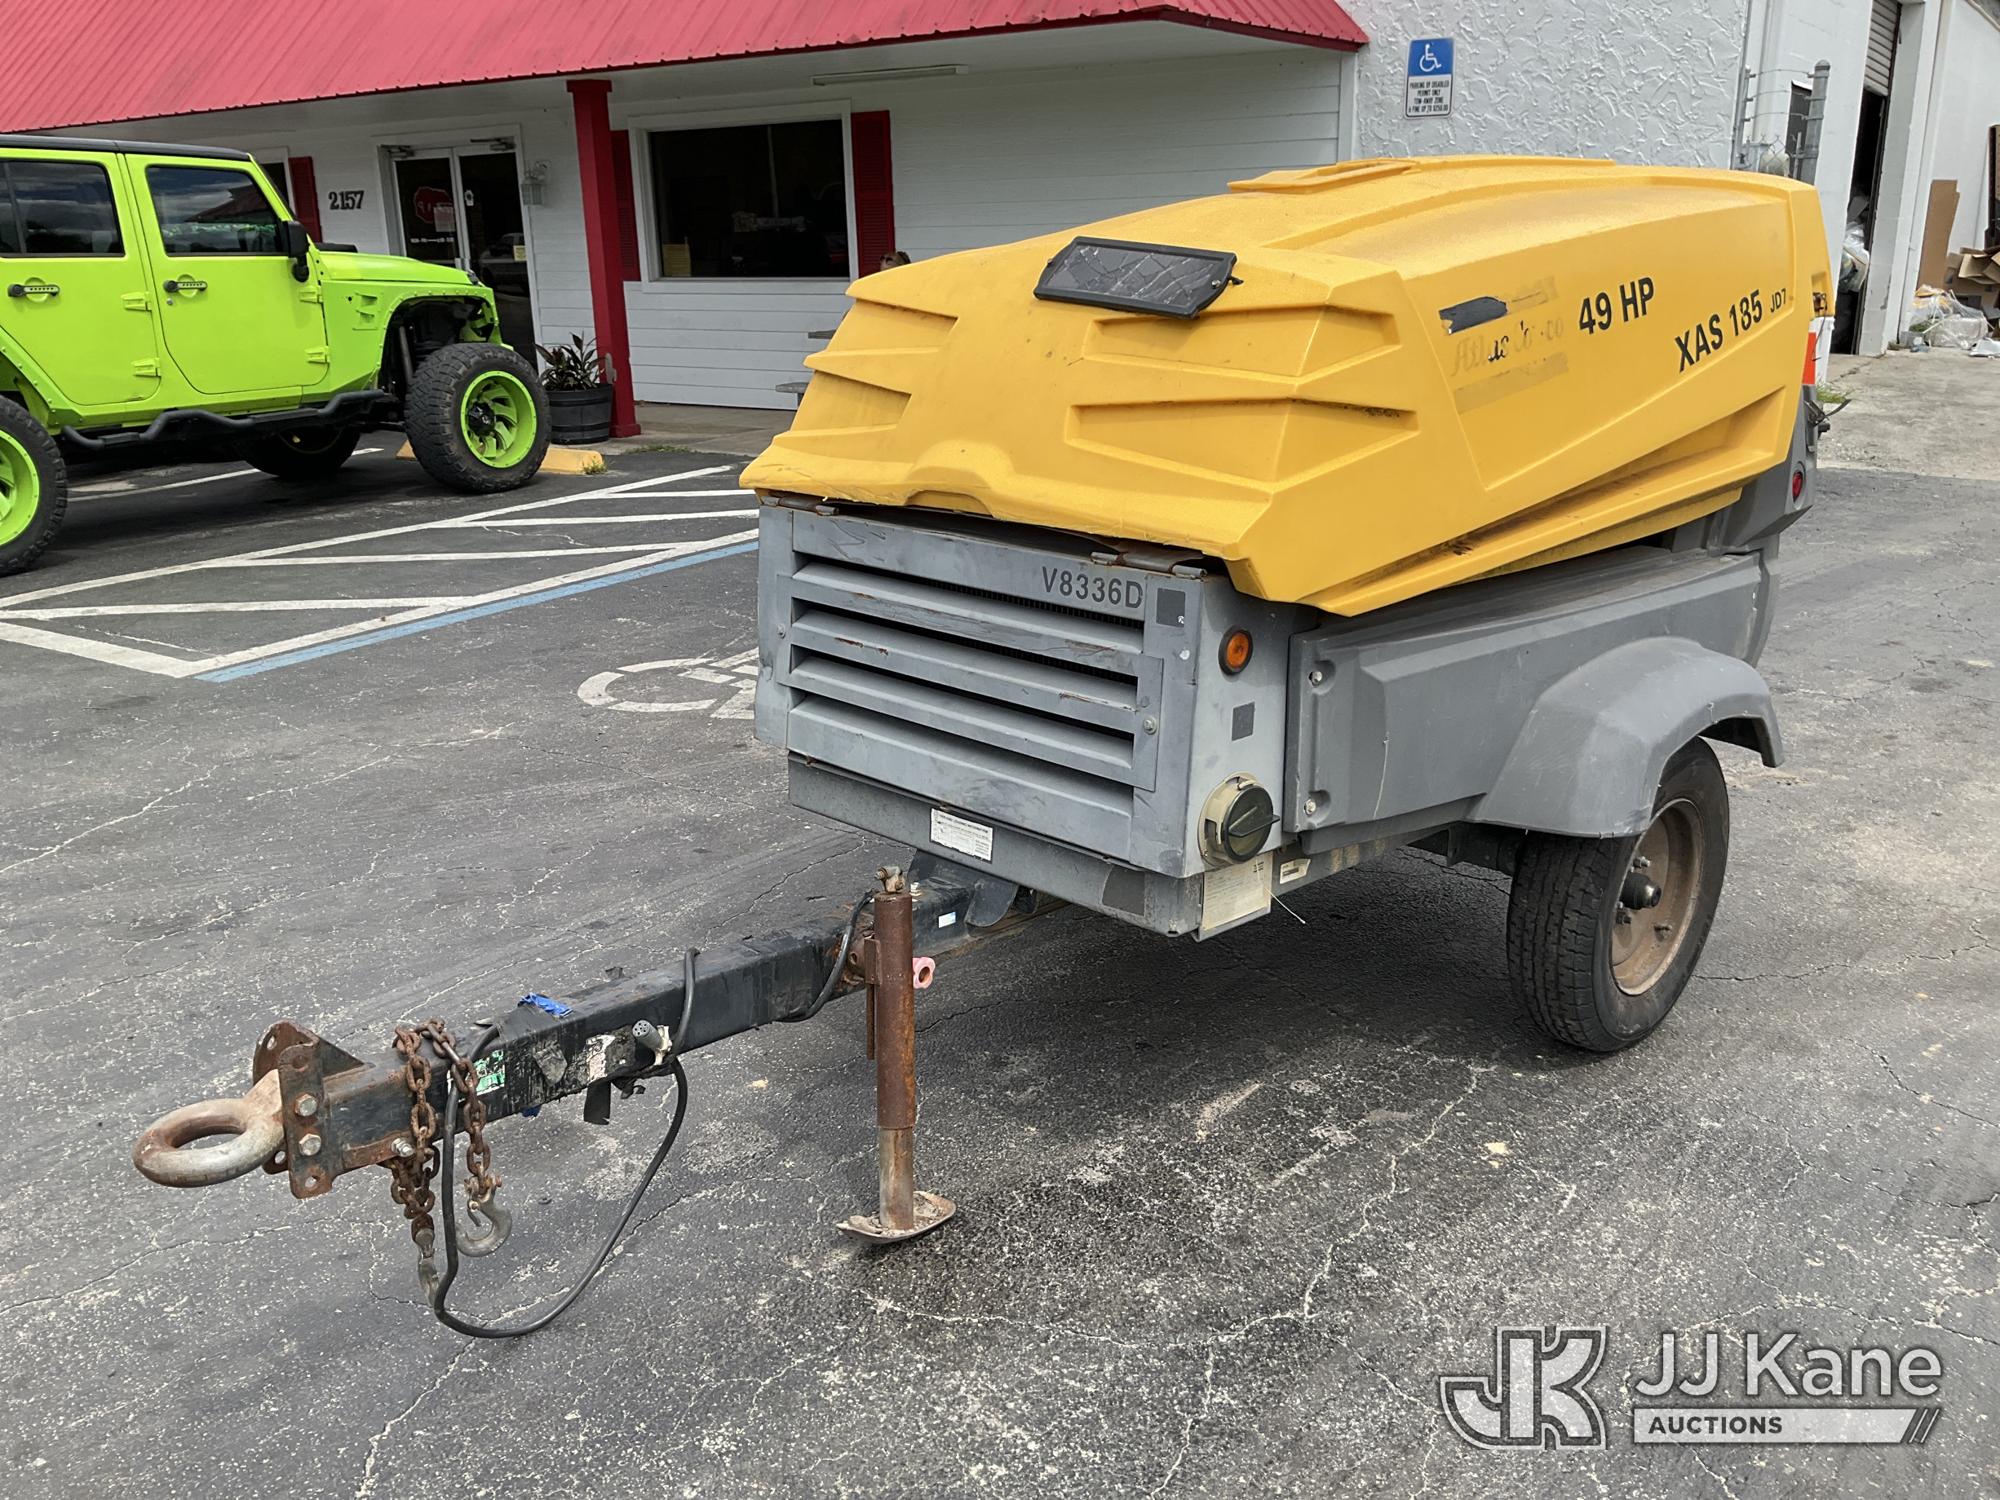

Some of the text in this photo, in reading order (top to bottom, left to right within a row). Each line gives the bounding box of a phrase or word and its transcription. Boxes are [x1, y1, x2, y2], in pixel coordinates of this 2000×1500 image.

[328, 190, 365, 210] 2157
[1579, 277, 1654, 335] 49 HP
[1675, 288, 1786, 373] XAS 185 JD7
[1042, 566, 1144, 609] V8336D
